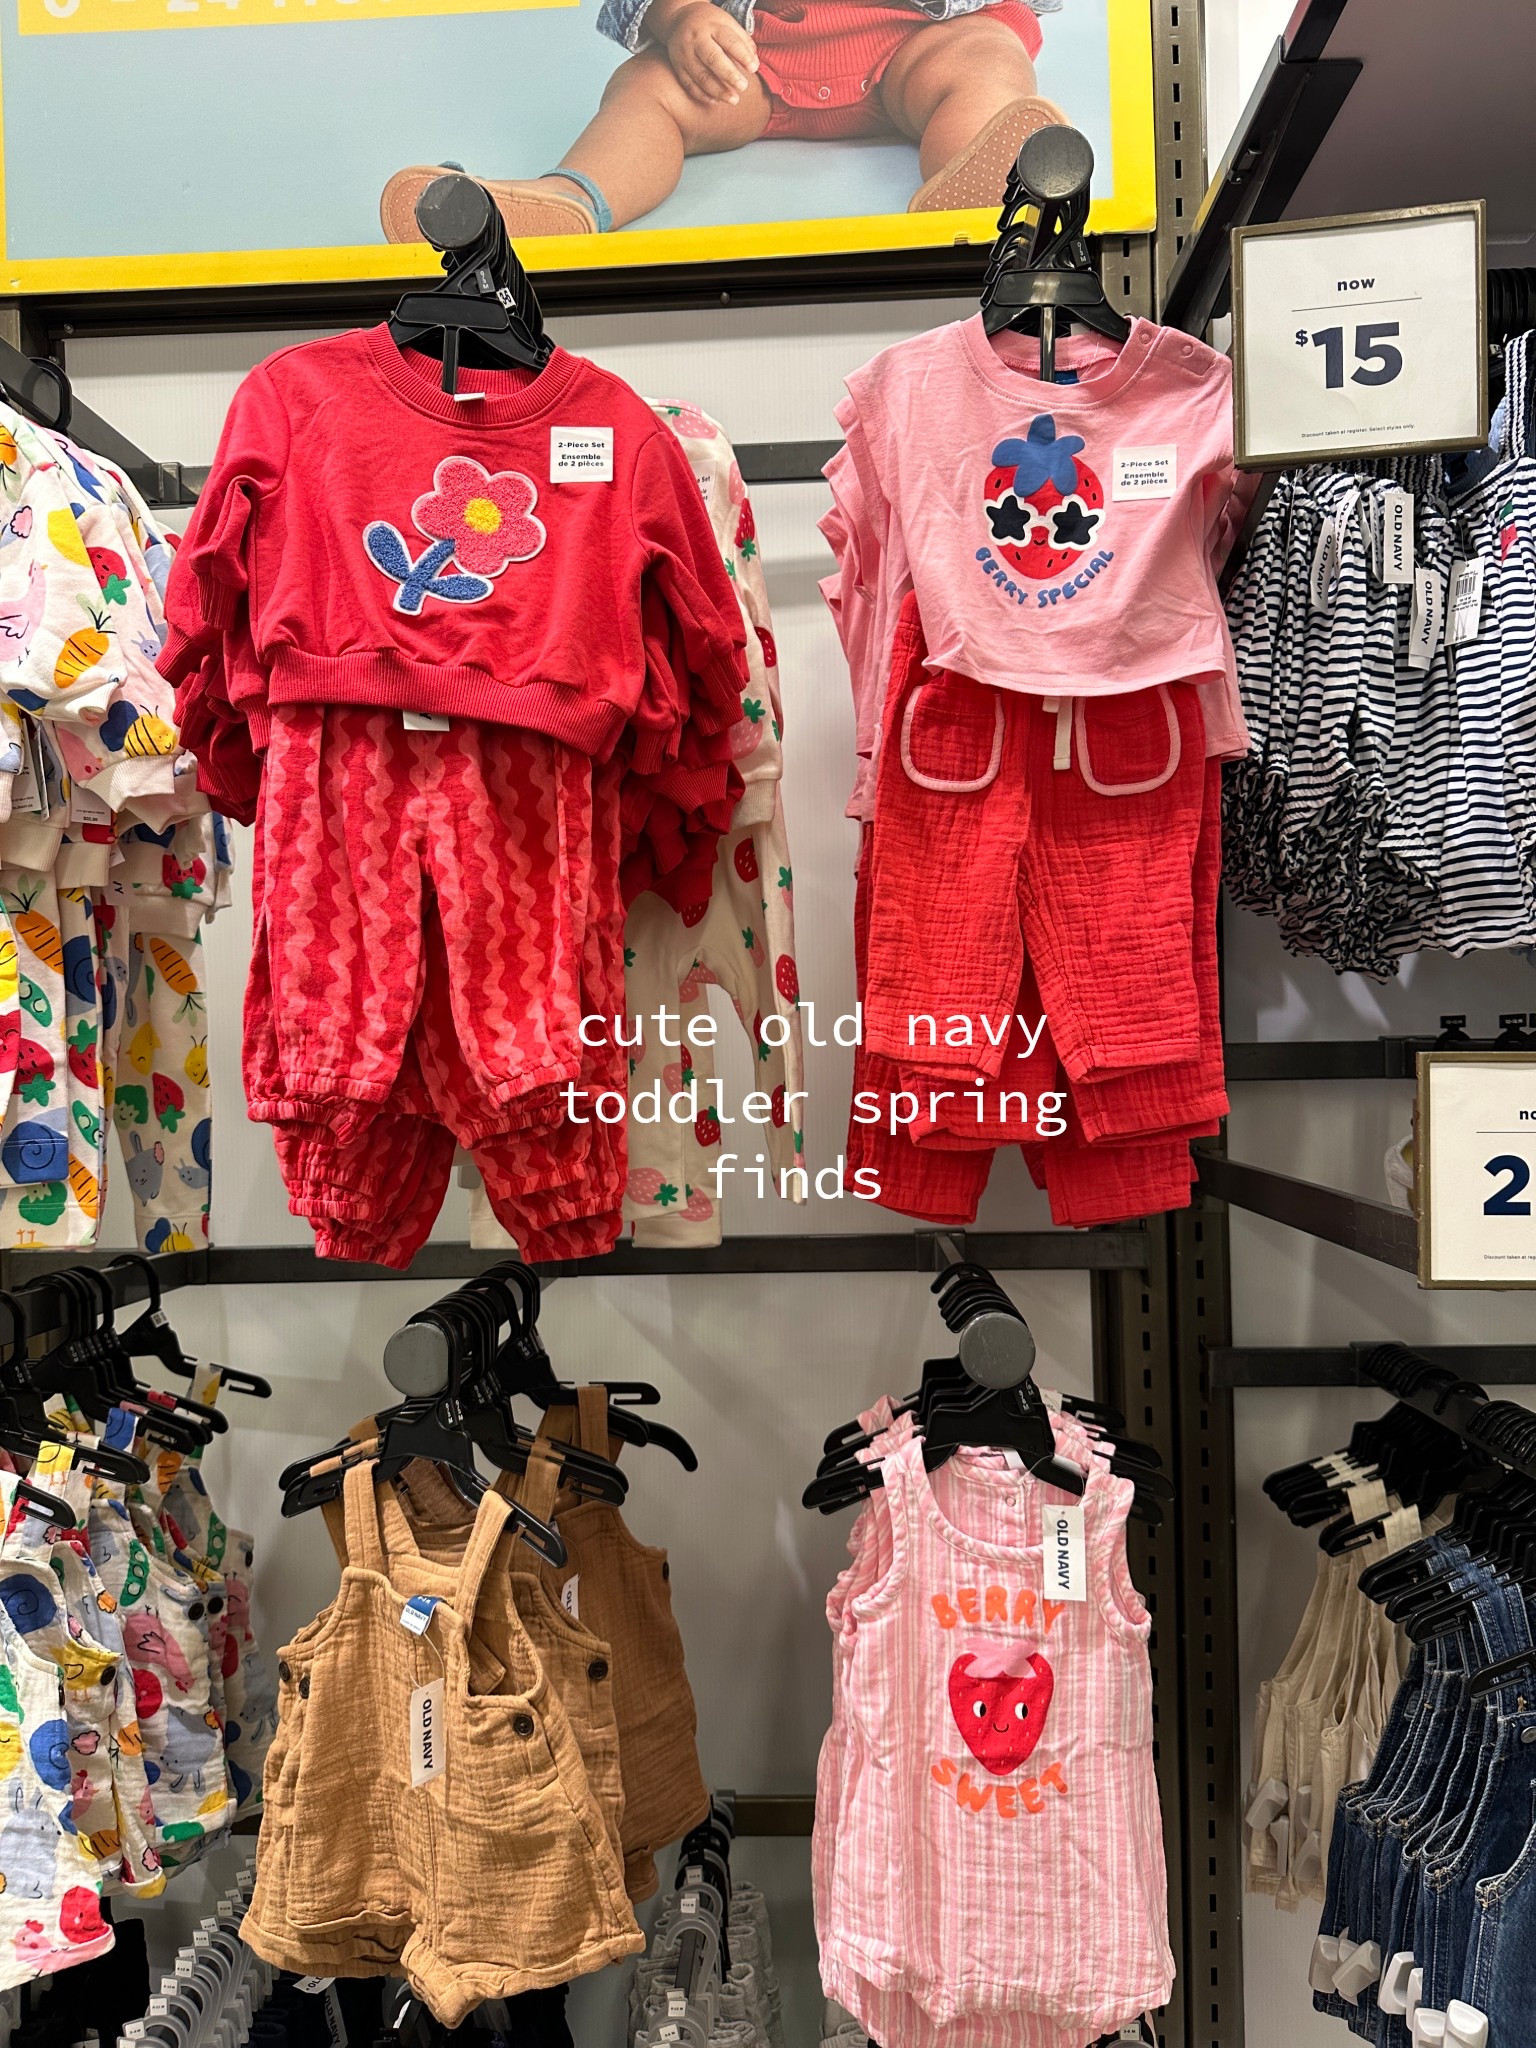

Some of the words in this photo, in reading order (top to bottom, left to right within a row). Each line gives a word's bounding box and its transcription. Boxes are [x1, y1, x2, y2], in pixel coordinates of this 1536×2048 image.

[1337, 278, 1376, 291] now
[1295, 321, 1403, 389] $15
[578, 460, 604, 468] pièces
[1124, 471, 1165, 479] Ensemble
[1141, 478, 1168, 486] pièces
[1338, 502, 1349, 529] OLD
[1394, 504, 1403, 531] OLD
[1322, 534, 1332, 561] OLD
[1393, 534, 1403, 571] NAVY
[975, 547, 1028, 605] BERRY
[1037, 550, 1114, 608] SPECIAL
[1316, 563, 1326, 599] NAVY
[1424, 580, 1433, 606] OLD
[1421, 608, 1434, 645] NAVY
[1483, 1154, 1532, 1216] 2
[1057, 1520, 1069, 1547] OLD
[1057, 1549, 1070, 1591] NAVY
[404, 1607, 415, 1617] OLD
[413, 1611, 428, 1622] NAVY
[931, 1585, 1066, 1635] BERRY
[422, 1698, 433, 1728] OLD
[422, 1730, 434, 1769] NAVY
[930, 1758, 1068, 1819] SWEET
[325, 1995, 334, 2016] OLD
[328, 2016, 341, 2044] NAVY
